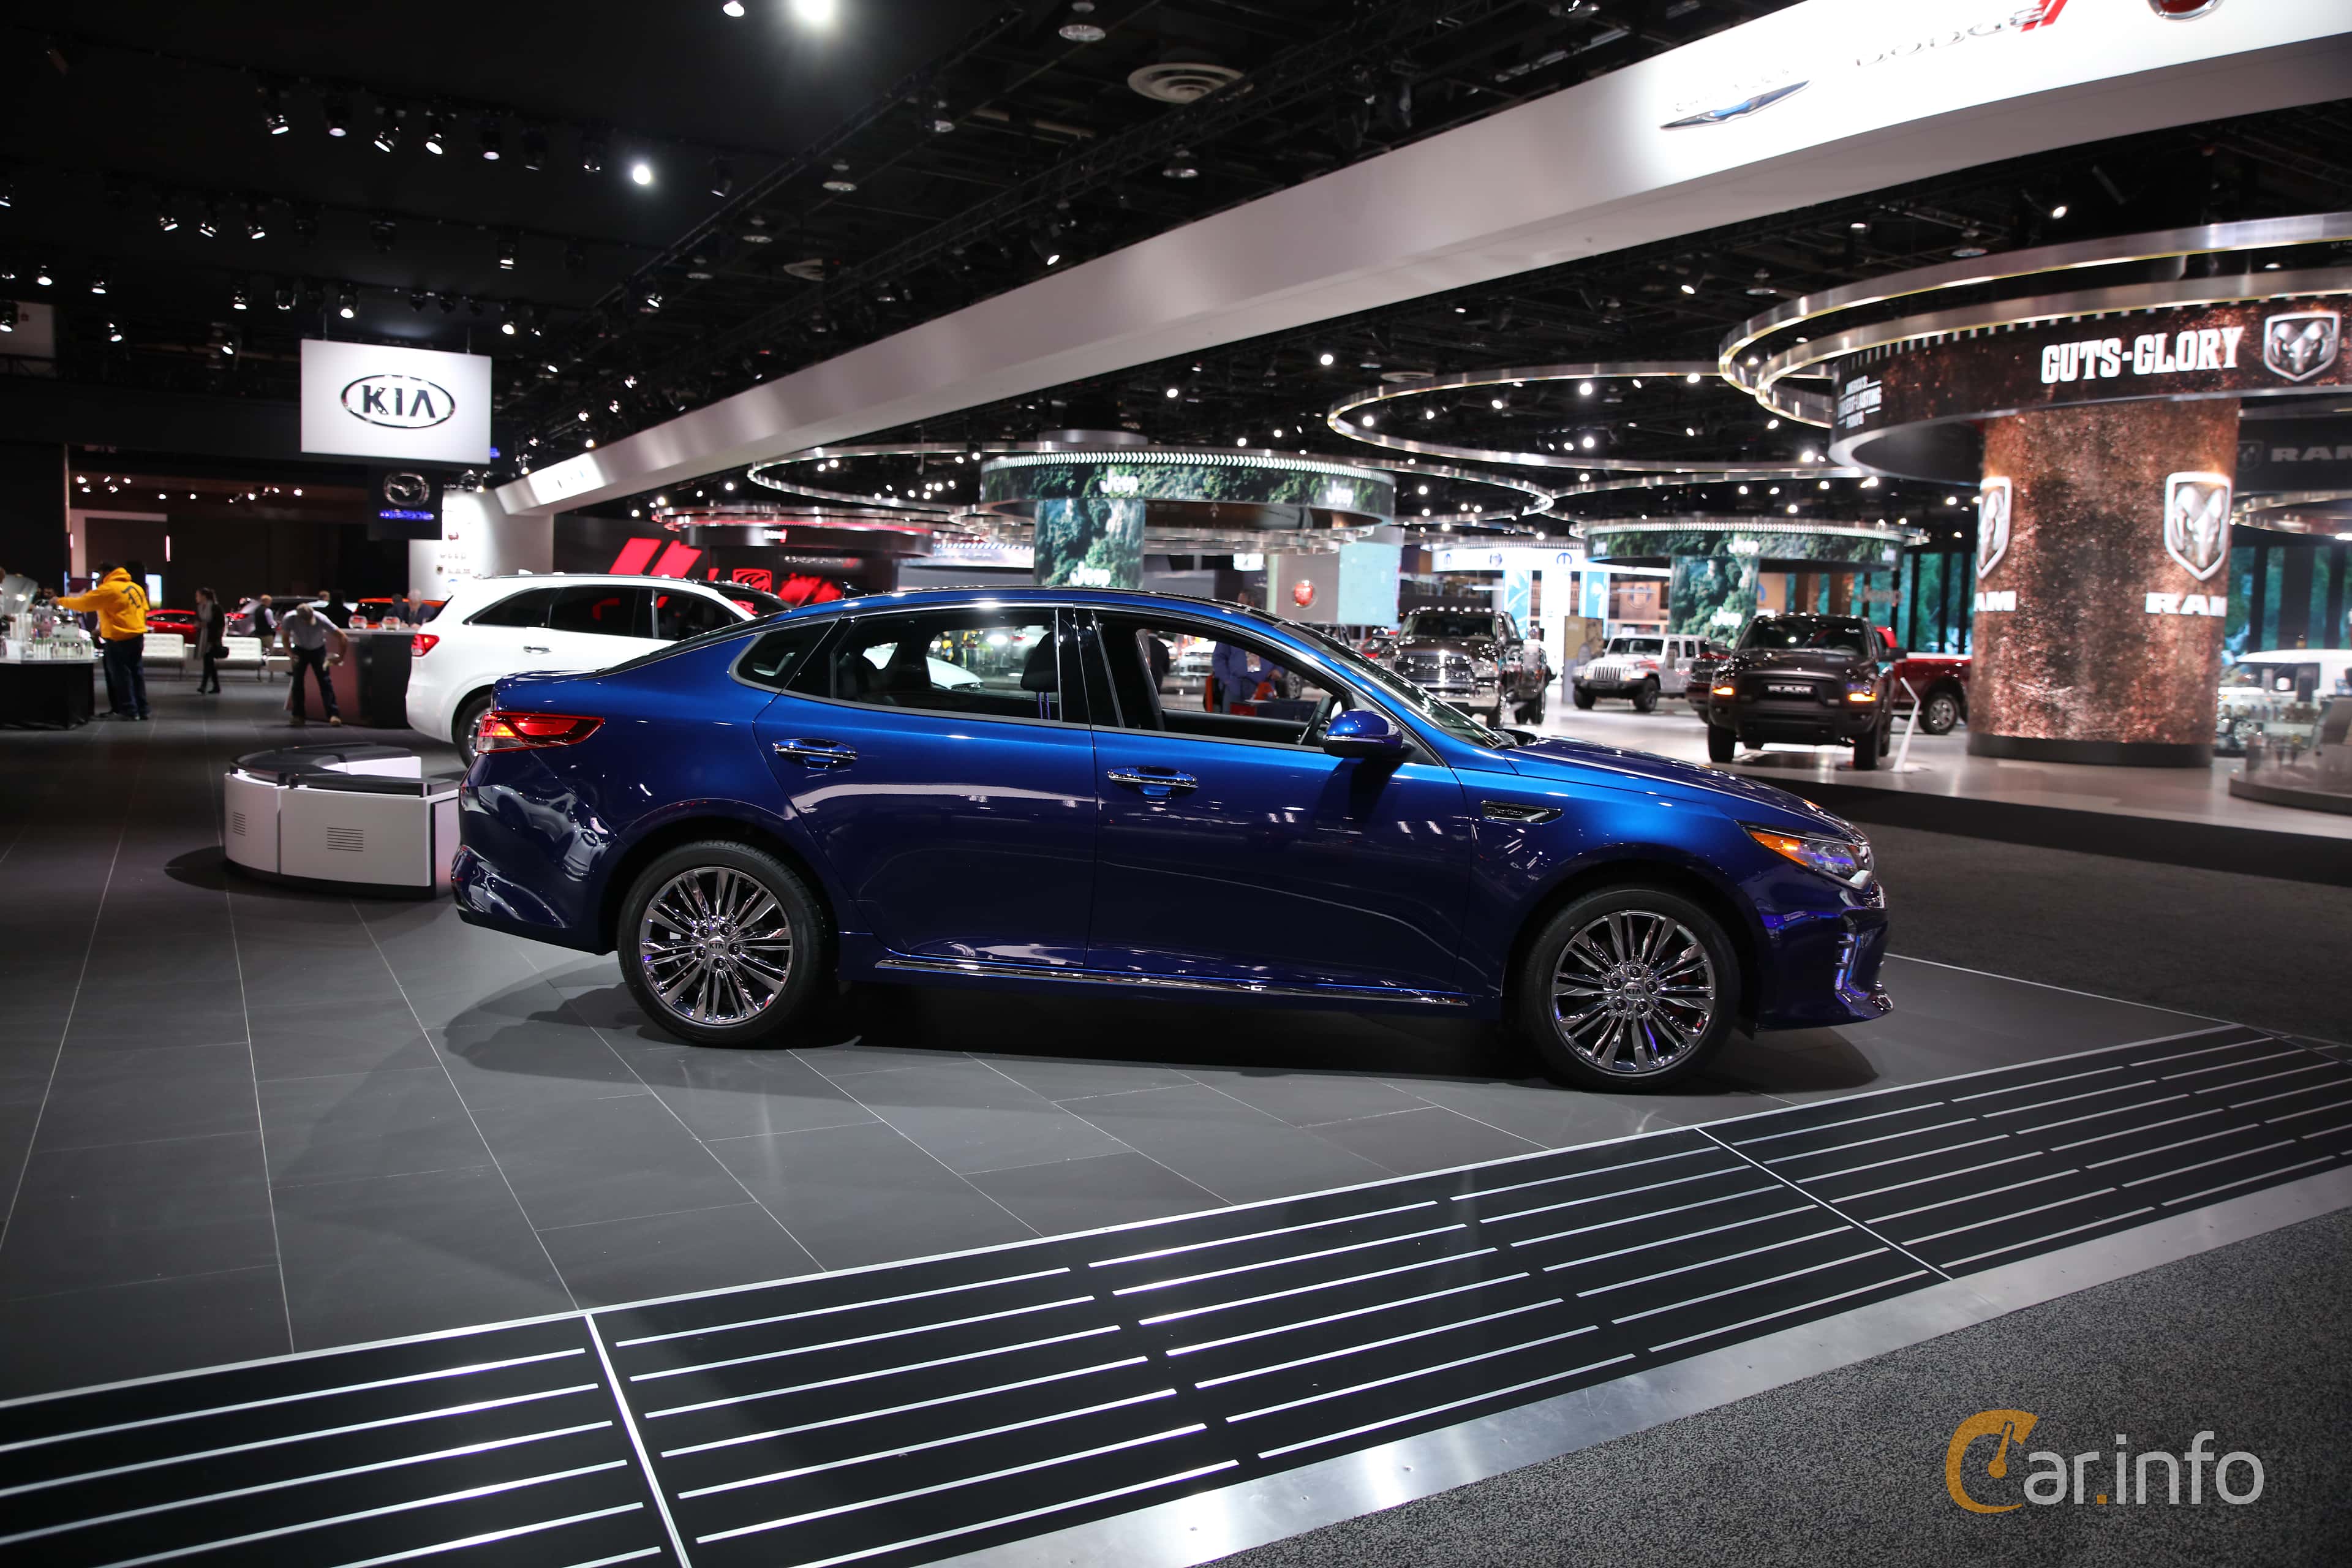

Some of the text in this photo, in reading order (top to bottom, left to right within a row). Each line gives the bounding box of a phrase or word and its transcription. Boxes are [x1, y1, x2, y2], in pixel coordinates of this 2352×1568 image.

[2041, 326, 2244, 383] GUTS-GLORY
[362, 385, 435, 418] KIA
[1099, 469, 1139, 496] Jeep
[1326, 480, 1354, 508] Jeep
[1069, 561, 1110, 587] Jeep
[1710, 606, 1743, 630] Jeep
